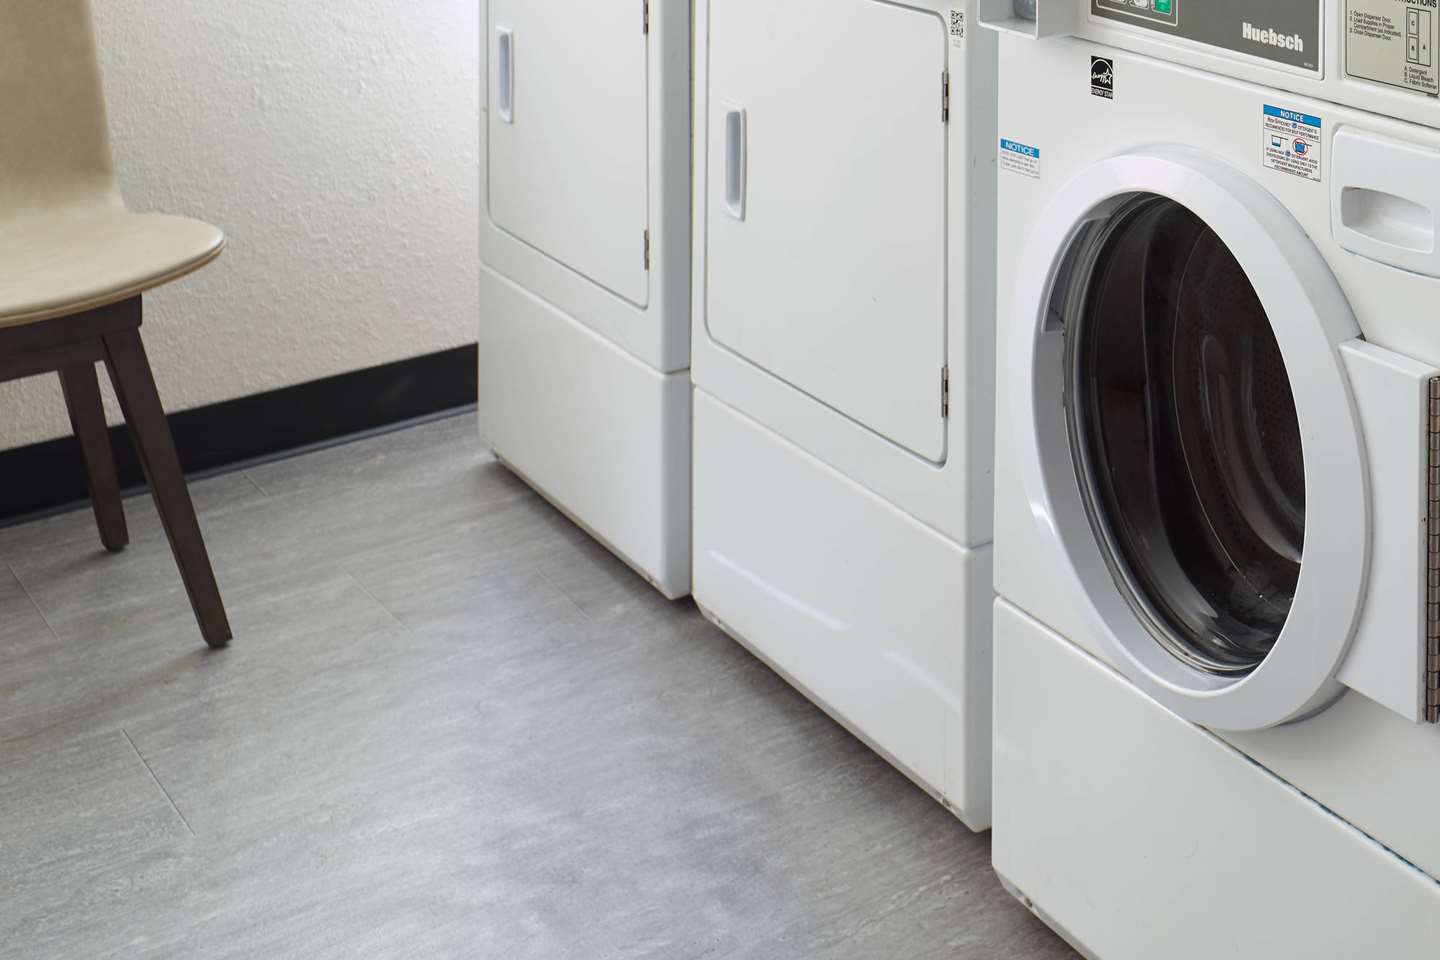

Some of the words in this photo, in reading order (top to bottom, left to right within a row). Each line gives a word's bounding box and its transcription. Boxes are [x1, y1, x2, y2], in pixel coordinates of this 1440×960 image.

[1242, 22, 1304, 52] Huebsch
[1280, 109, 1304, 122] NOTICE
[1005, 141, 1034, 156] NOTICE
